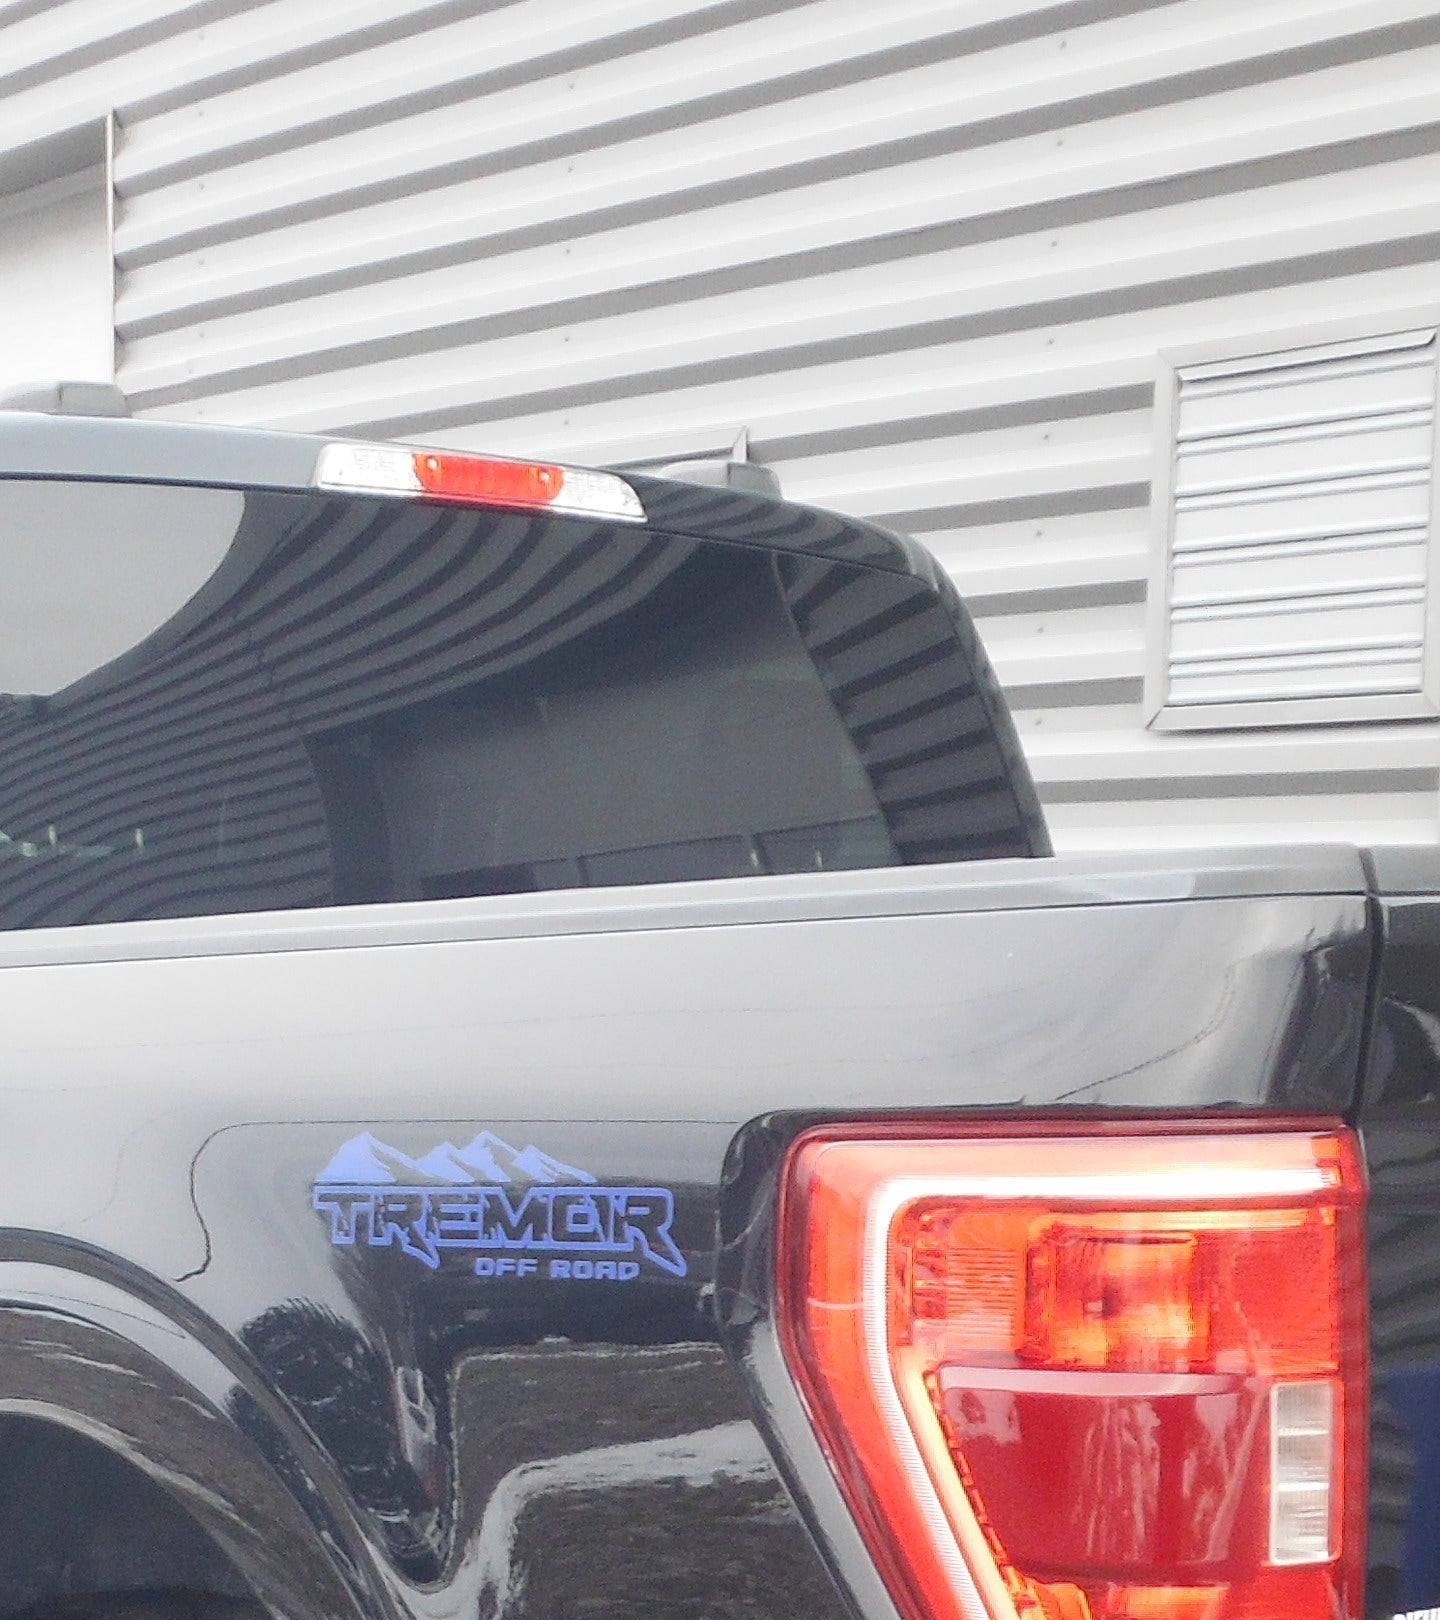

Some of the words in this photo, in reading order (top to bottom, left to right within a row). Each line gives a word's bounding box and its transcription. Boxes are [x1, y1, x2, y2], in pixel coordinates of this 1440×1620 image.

[312, 1185, 687, 1278] TREMOR
[474, 1256, 539, 1277] OFF
[549, 1257, 641, 1281] ROAD
